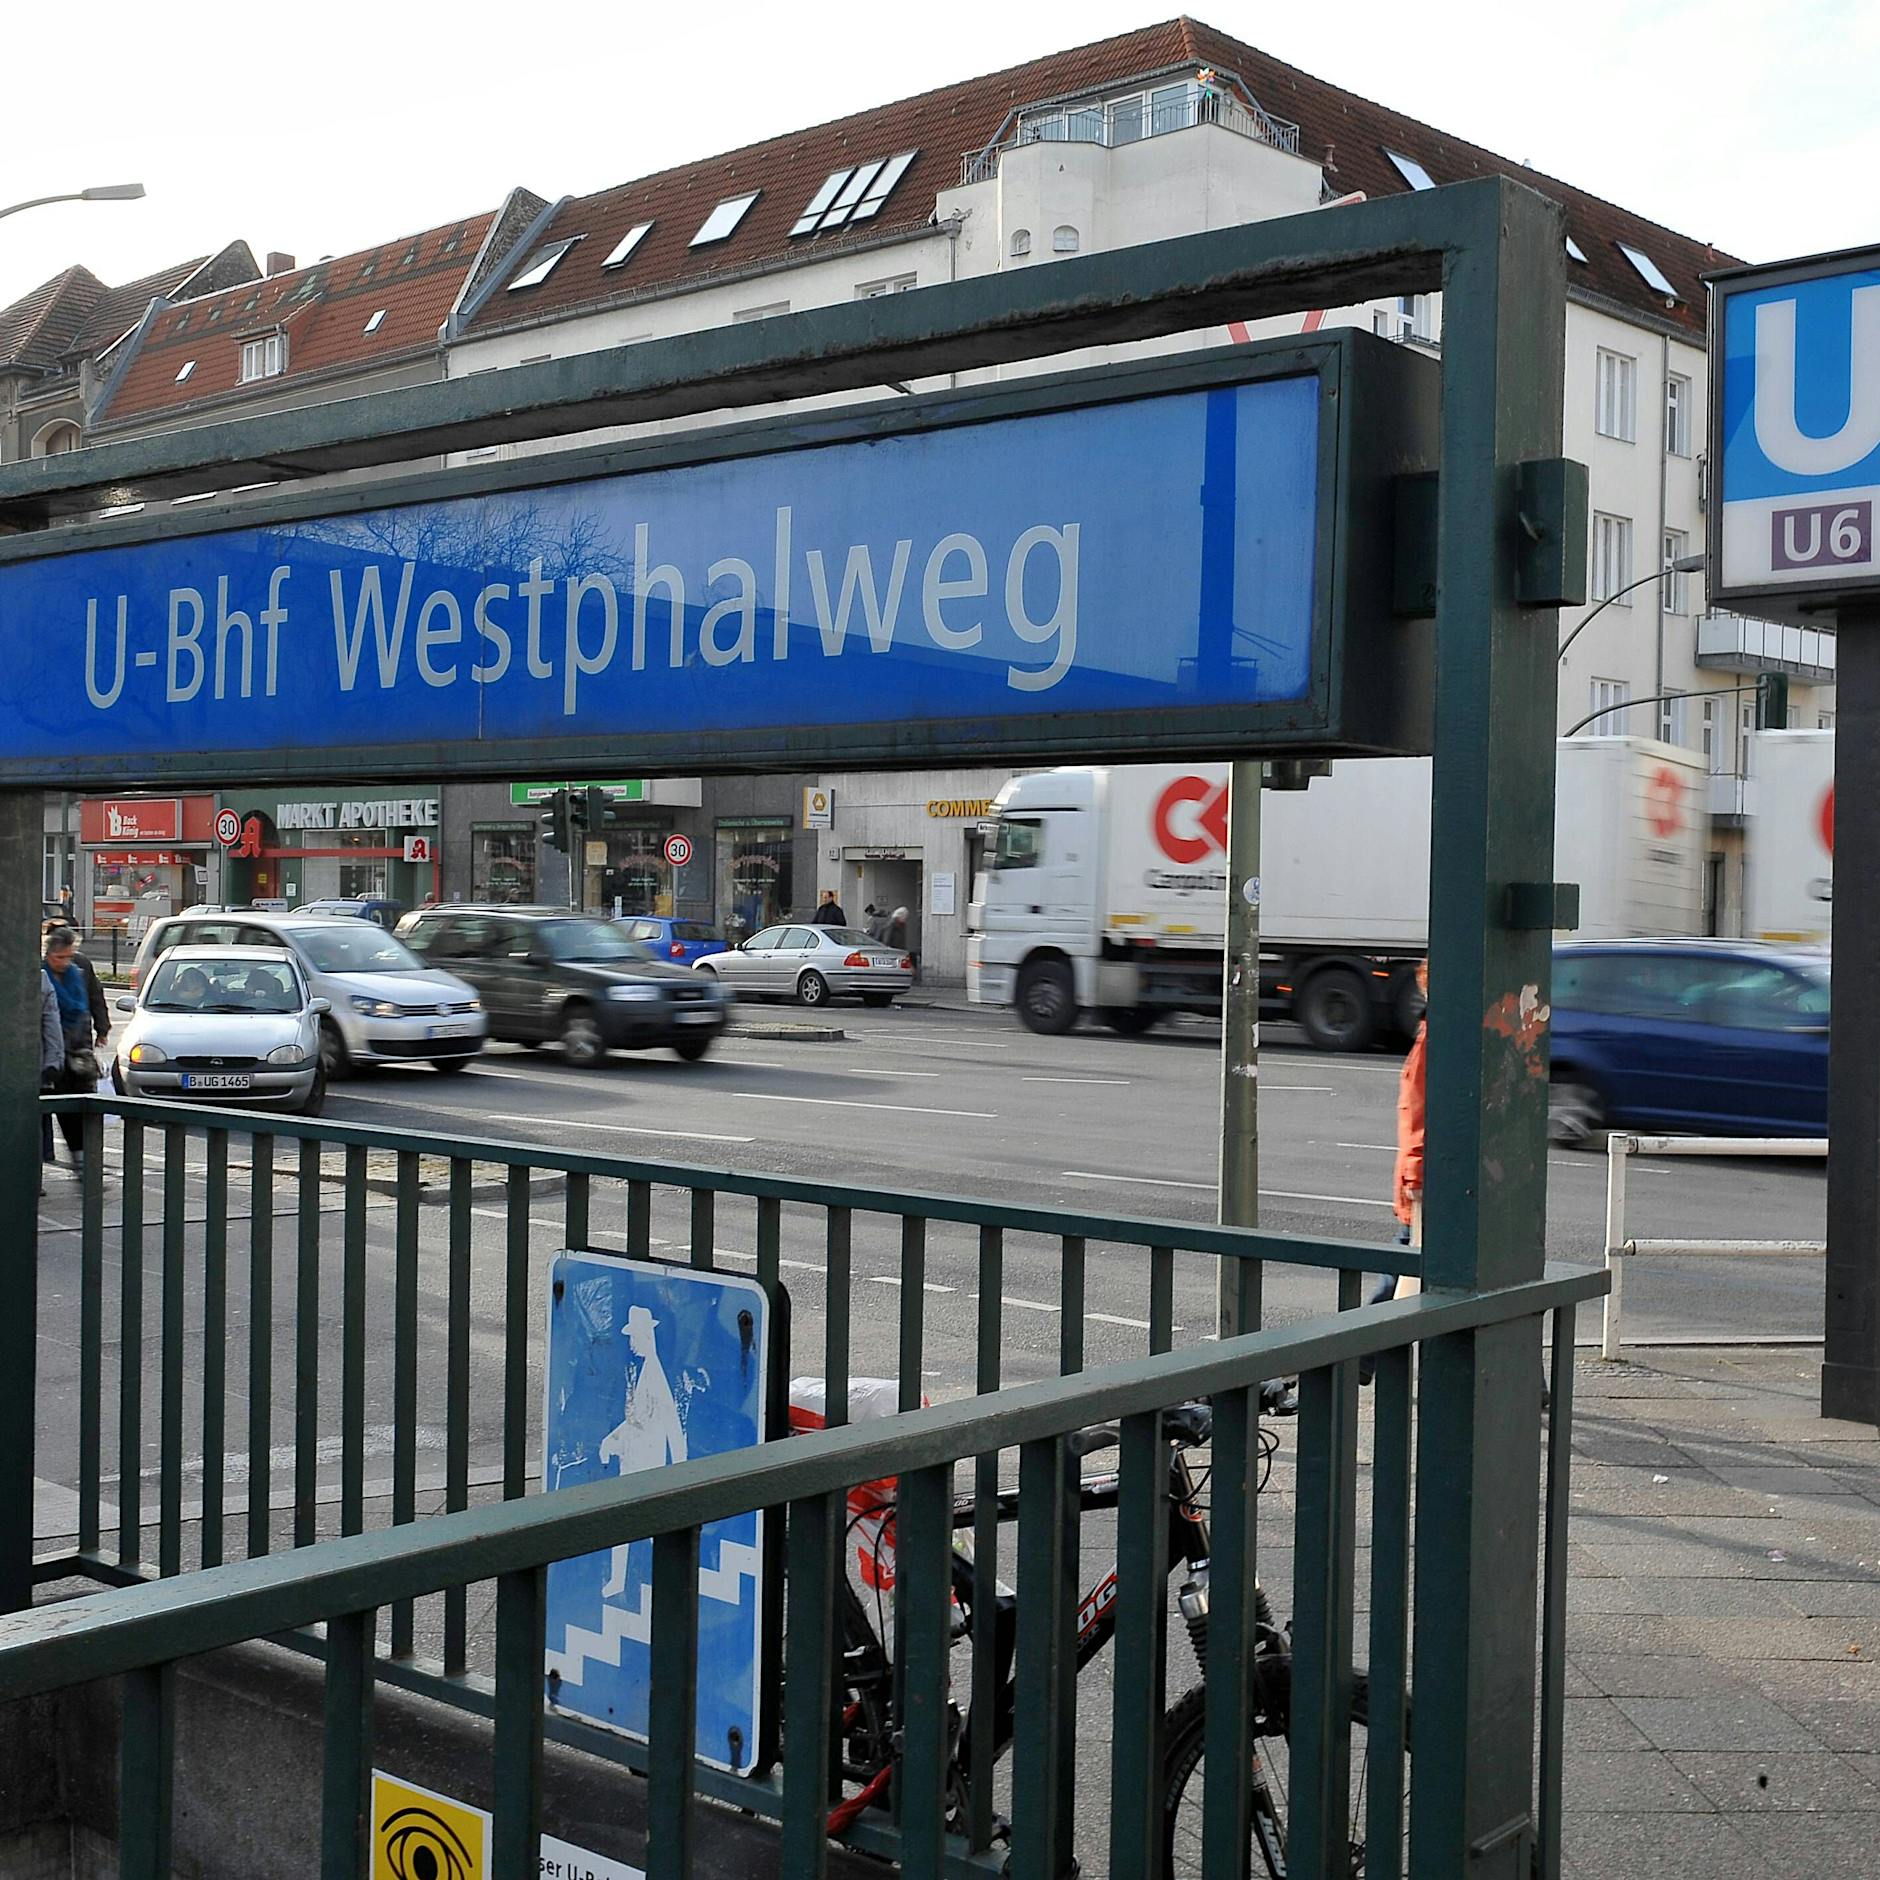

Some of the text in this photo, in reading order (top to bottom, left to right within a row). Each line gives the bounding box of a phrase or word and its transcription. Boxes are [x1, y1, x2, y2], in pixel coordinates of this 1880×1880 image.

[1754, 284, 1880, 475] U
[1783, 508, 1862, 562] U6
[85, 506, 1080, 715] U-Bhf Westphalweg
[220, 819, 235, 835] 30
[277, 802, 337, 829] MARKT
[338, 799, 439, 828] APOTHEKE
[670, 843, 687, 857] 30
